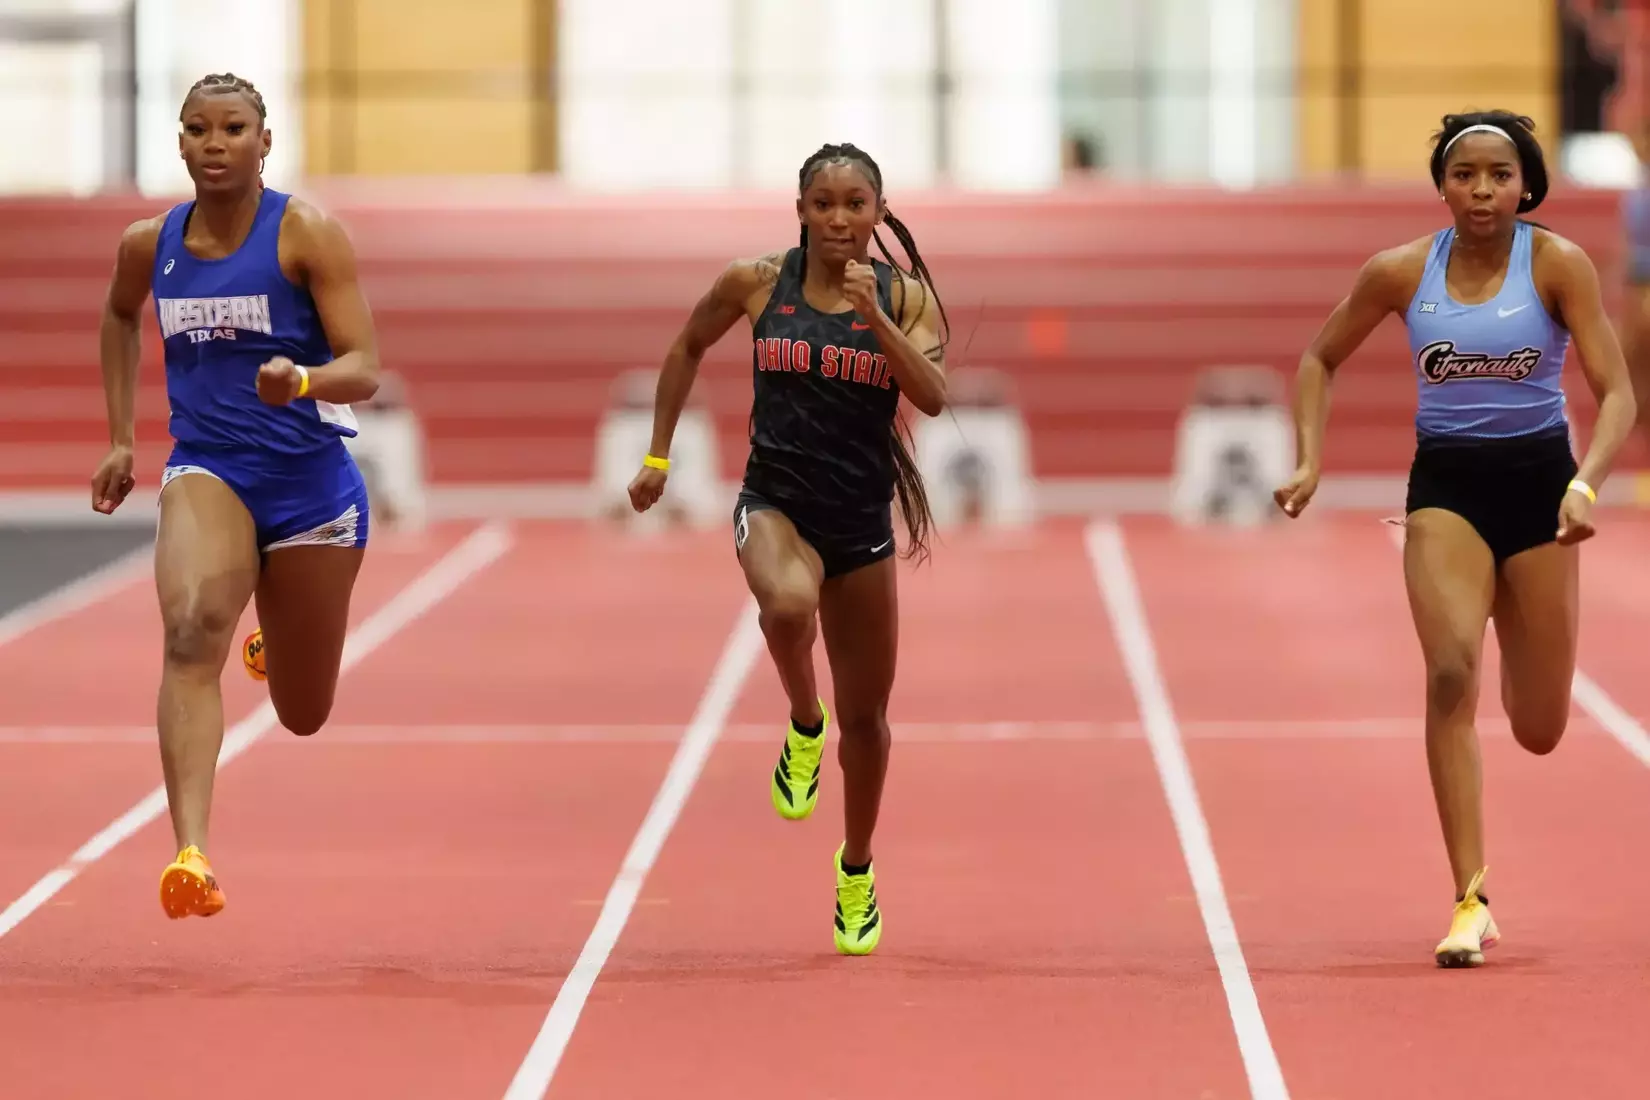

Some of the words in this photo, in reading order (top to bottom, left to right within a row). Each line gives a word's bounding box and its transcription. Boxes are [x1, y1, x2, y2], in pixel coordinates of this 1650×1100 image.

[158, 294, 272, 340] WESTERN
[186, 328, 237, 344] TEXAS
[756, 338, 811, 373] OHIO
[1418, 340, 1541, 385] Citronauts
